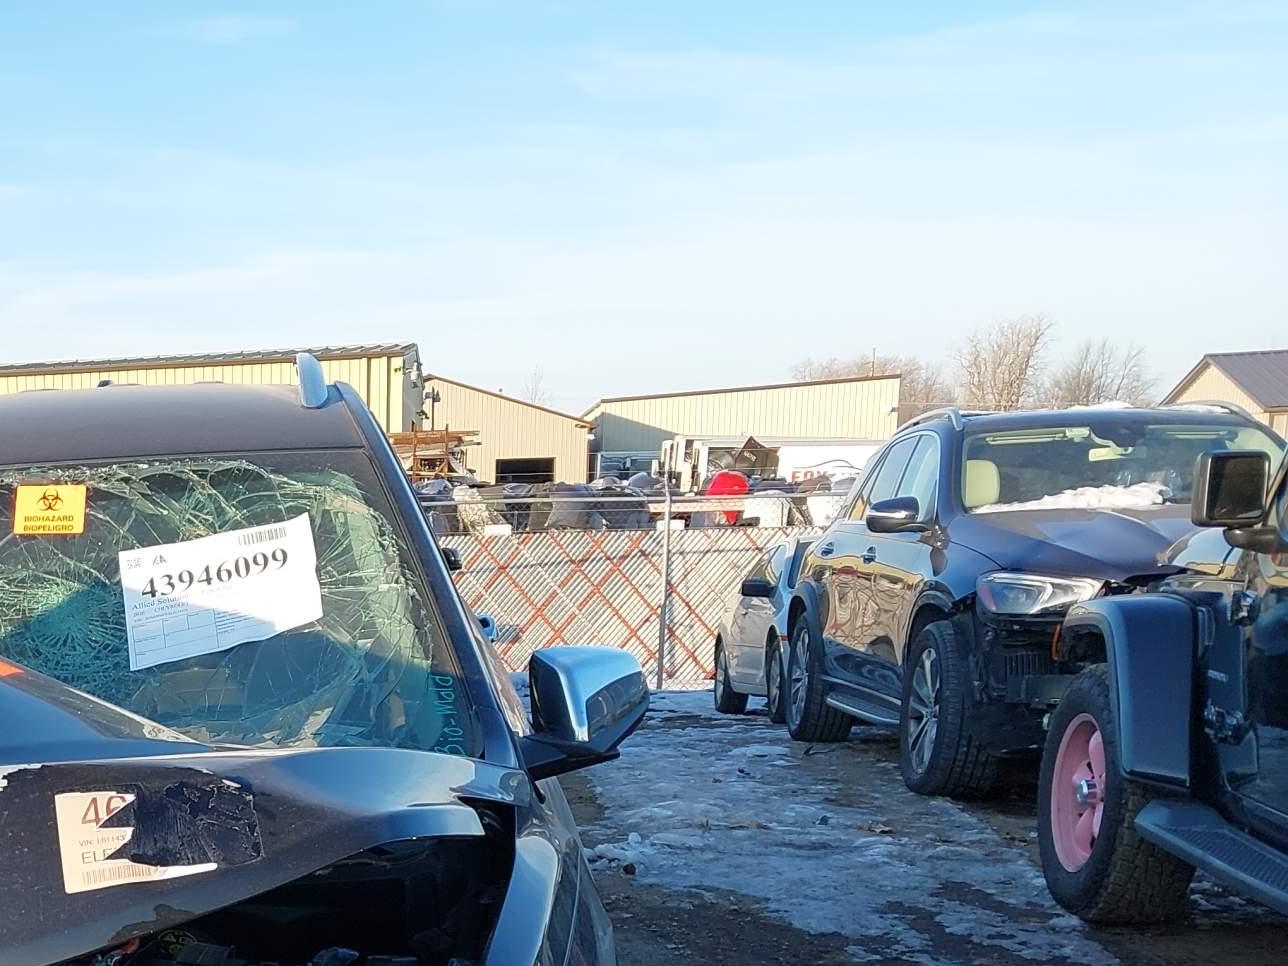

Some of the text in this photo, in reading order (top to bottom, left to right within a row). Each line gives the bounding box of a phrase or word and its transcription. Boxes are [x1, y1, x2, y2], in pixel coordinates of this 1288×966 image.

[24, 514, 74, 523] BIOHAZARD
[23, 524, 74, 532] BIOPELIGRO
[141, 547, 289, 598] 43946099
[132, 598, 156, 610] Allied
